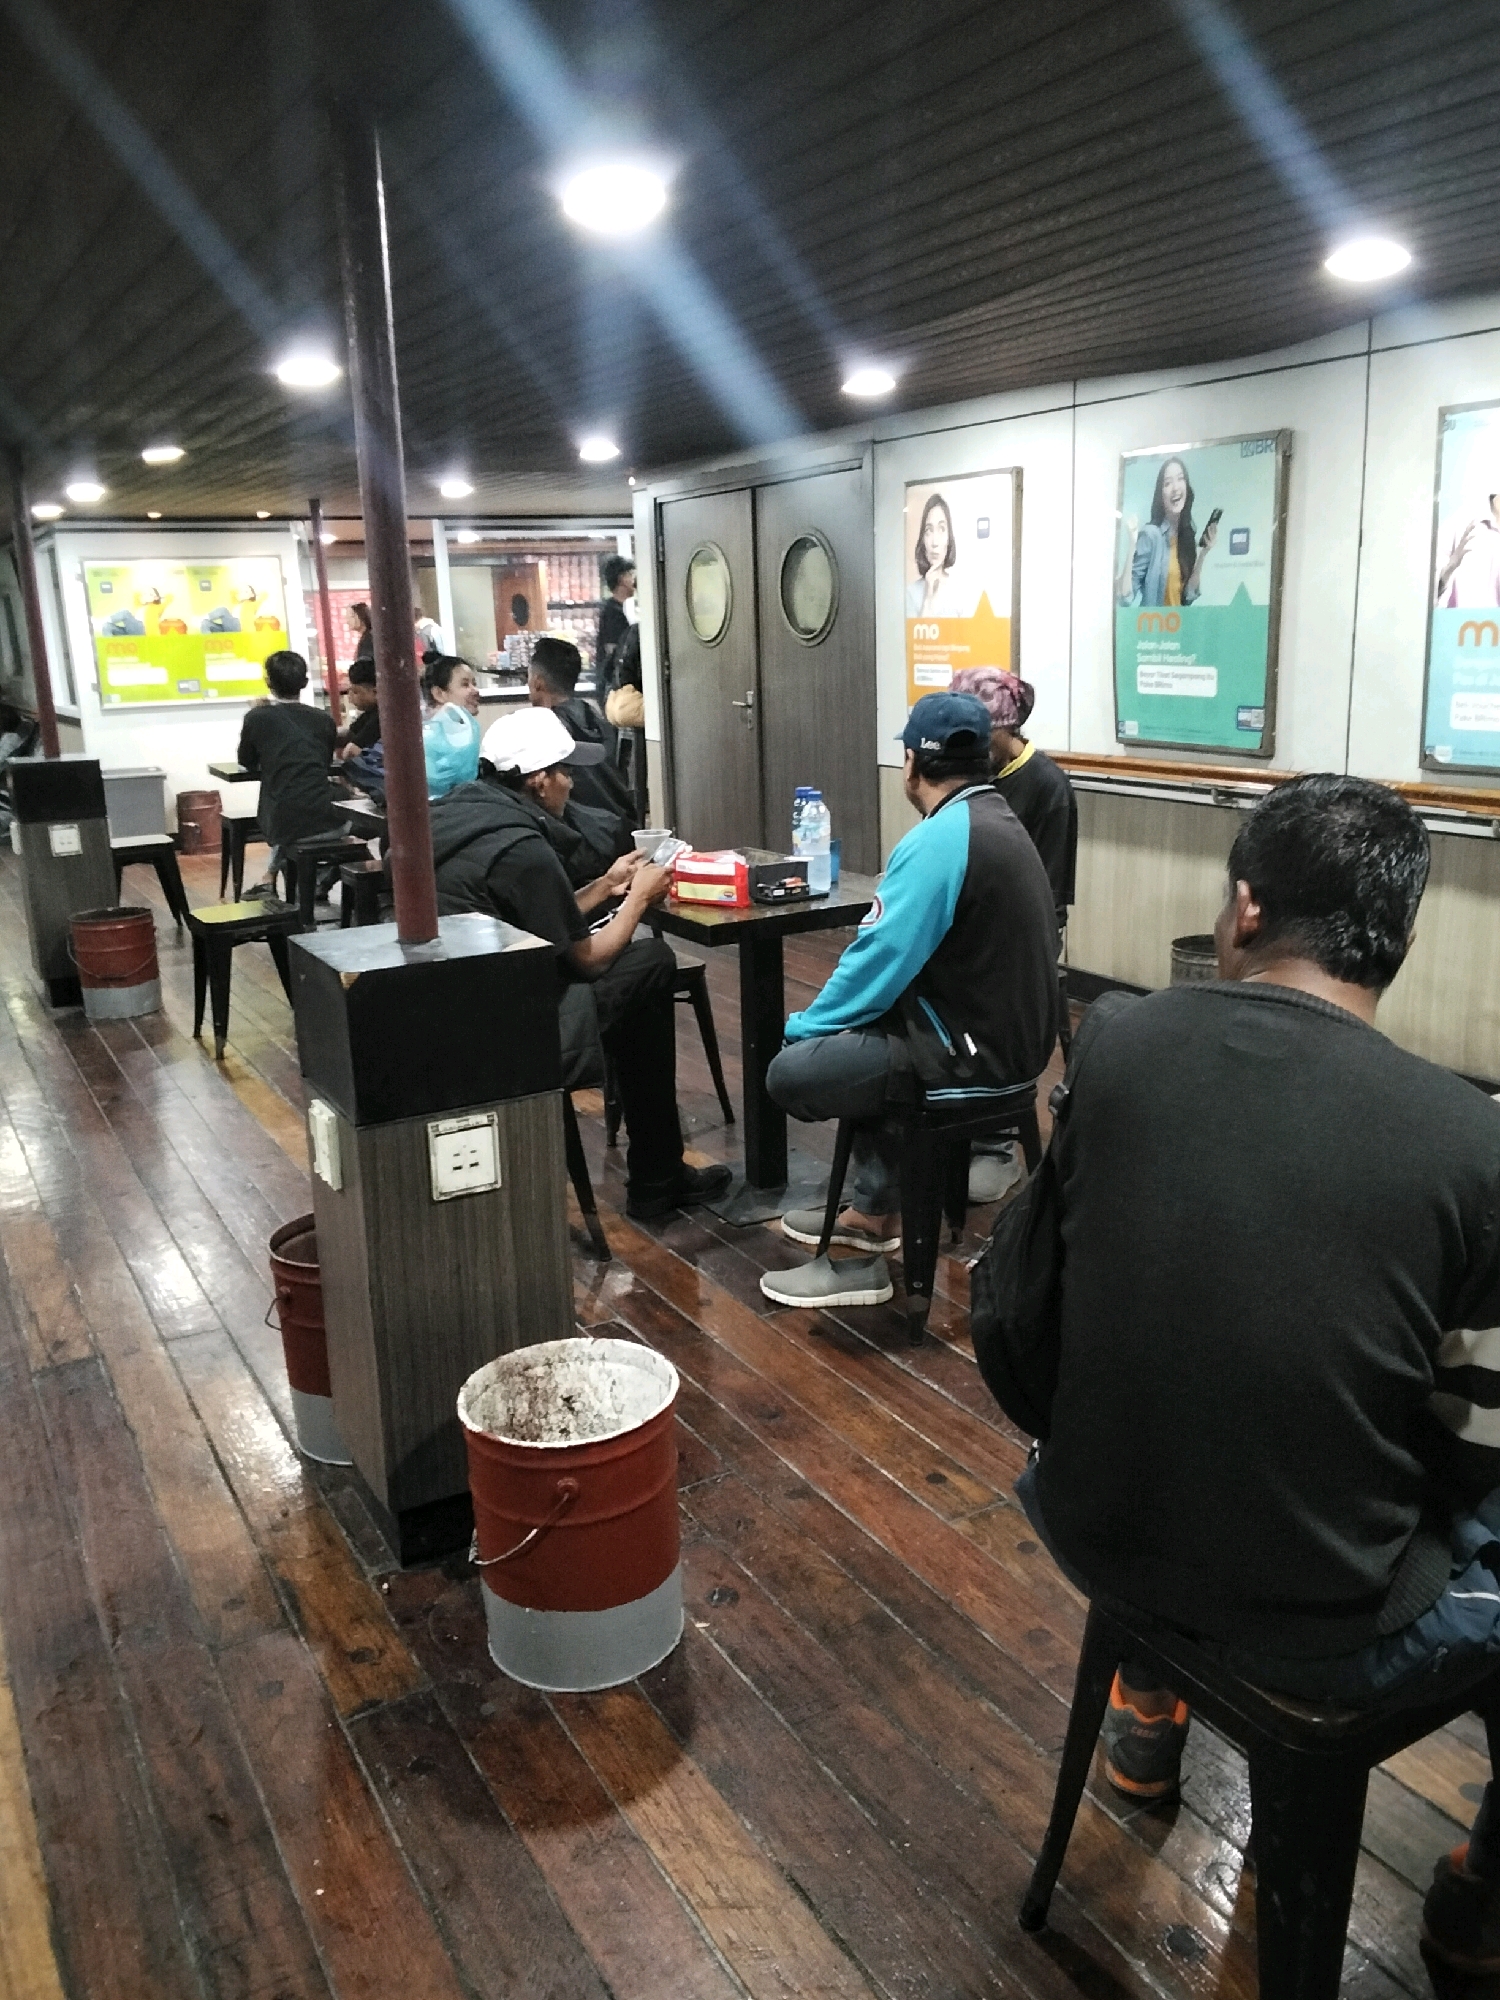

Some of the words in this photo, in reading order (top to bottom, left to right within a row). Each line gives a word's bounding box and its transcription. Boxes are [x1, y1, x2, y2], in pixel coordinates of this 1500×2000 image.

[1137, 611, 1181, 634] mo
[913, 623, 940, 640] mo
[920, 737, 941, 750] Lee
